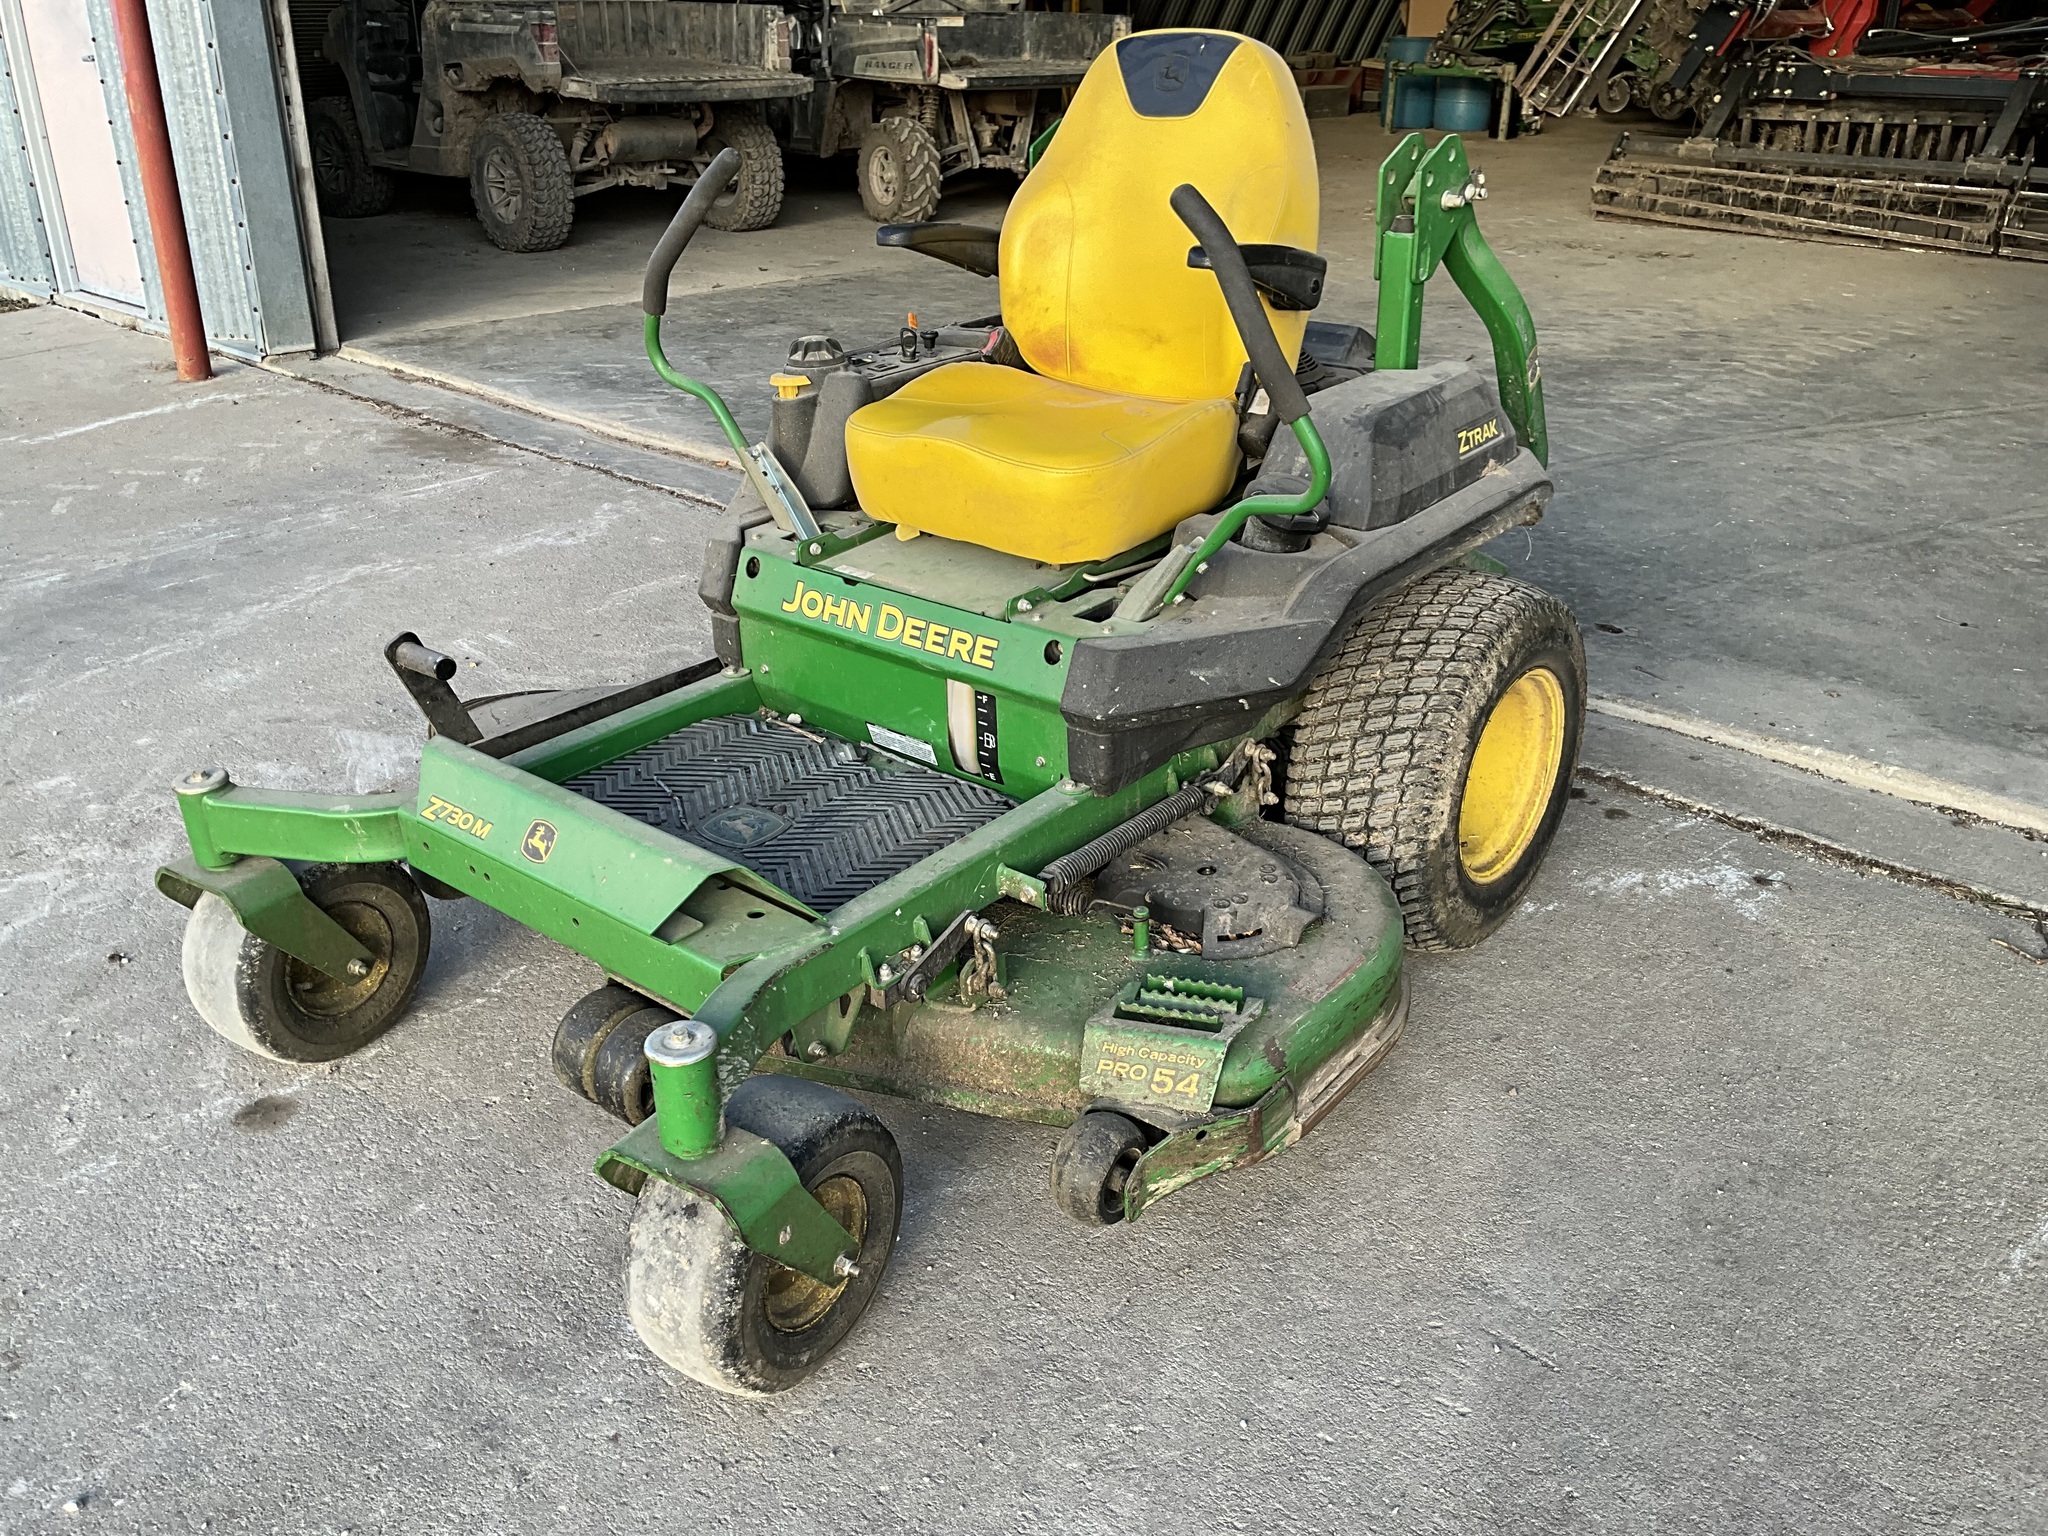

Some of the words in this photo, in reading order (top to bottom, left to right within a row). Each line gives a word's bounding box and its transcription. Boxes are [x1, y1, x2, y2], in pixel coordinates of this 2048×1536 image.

[864, 60, 914, 70] RANGER
[1458, 419, 1498, 453] ZTRAK
[781, 580, 873, 635] JOHN
[874, 602, 999, 670] DEERE
[982, 695, 988, 703] F
[989, 772, 996, 780] E
[1101, 1041, 1136, 1057] High
[1138, 1047, 1207, 1069] Capacity
[1096, 1059, 1149, 1080] PRO
[1150, 1066, 1201, 1099] 54
